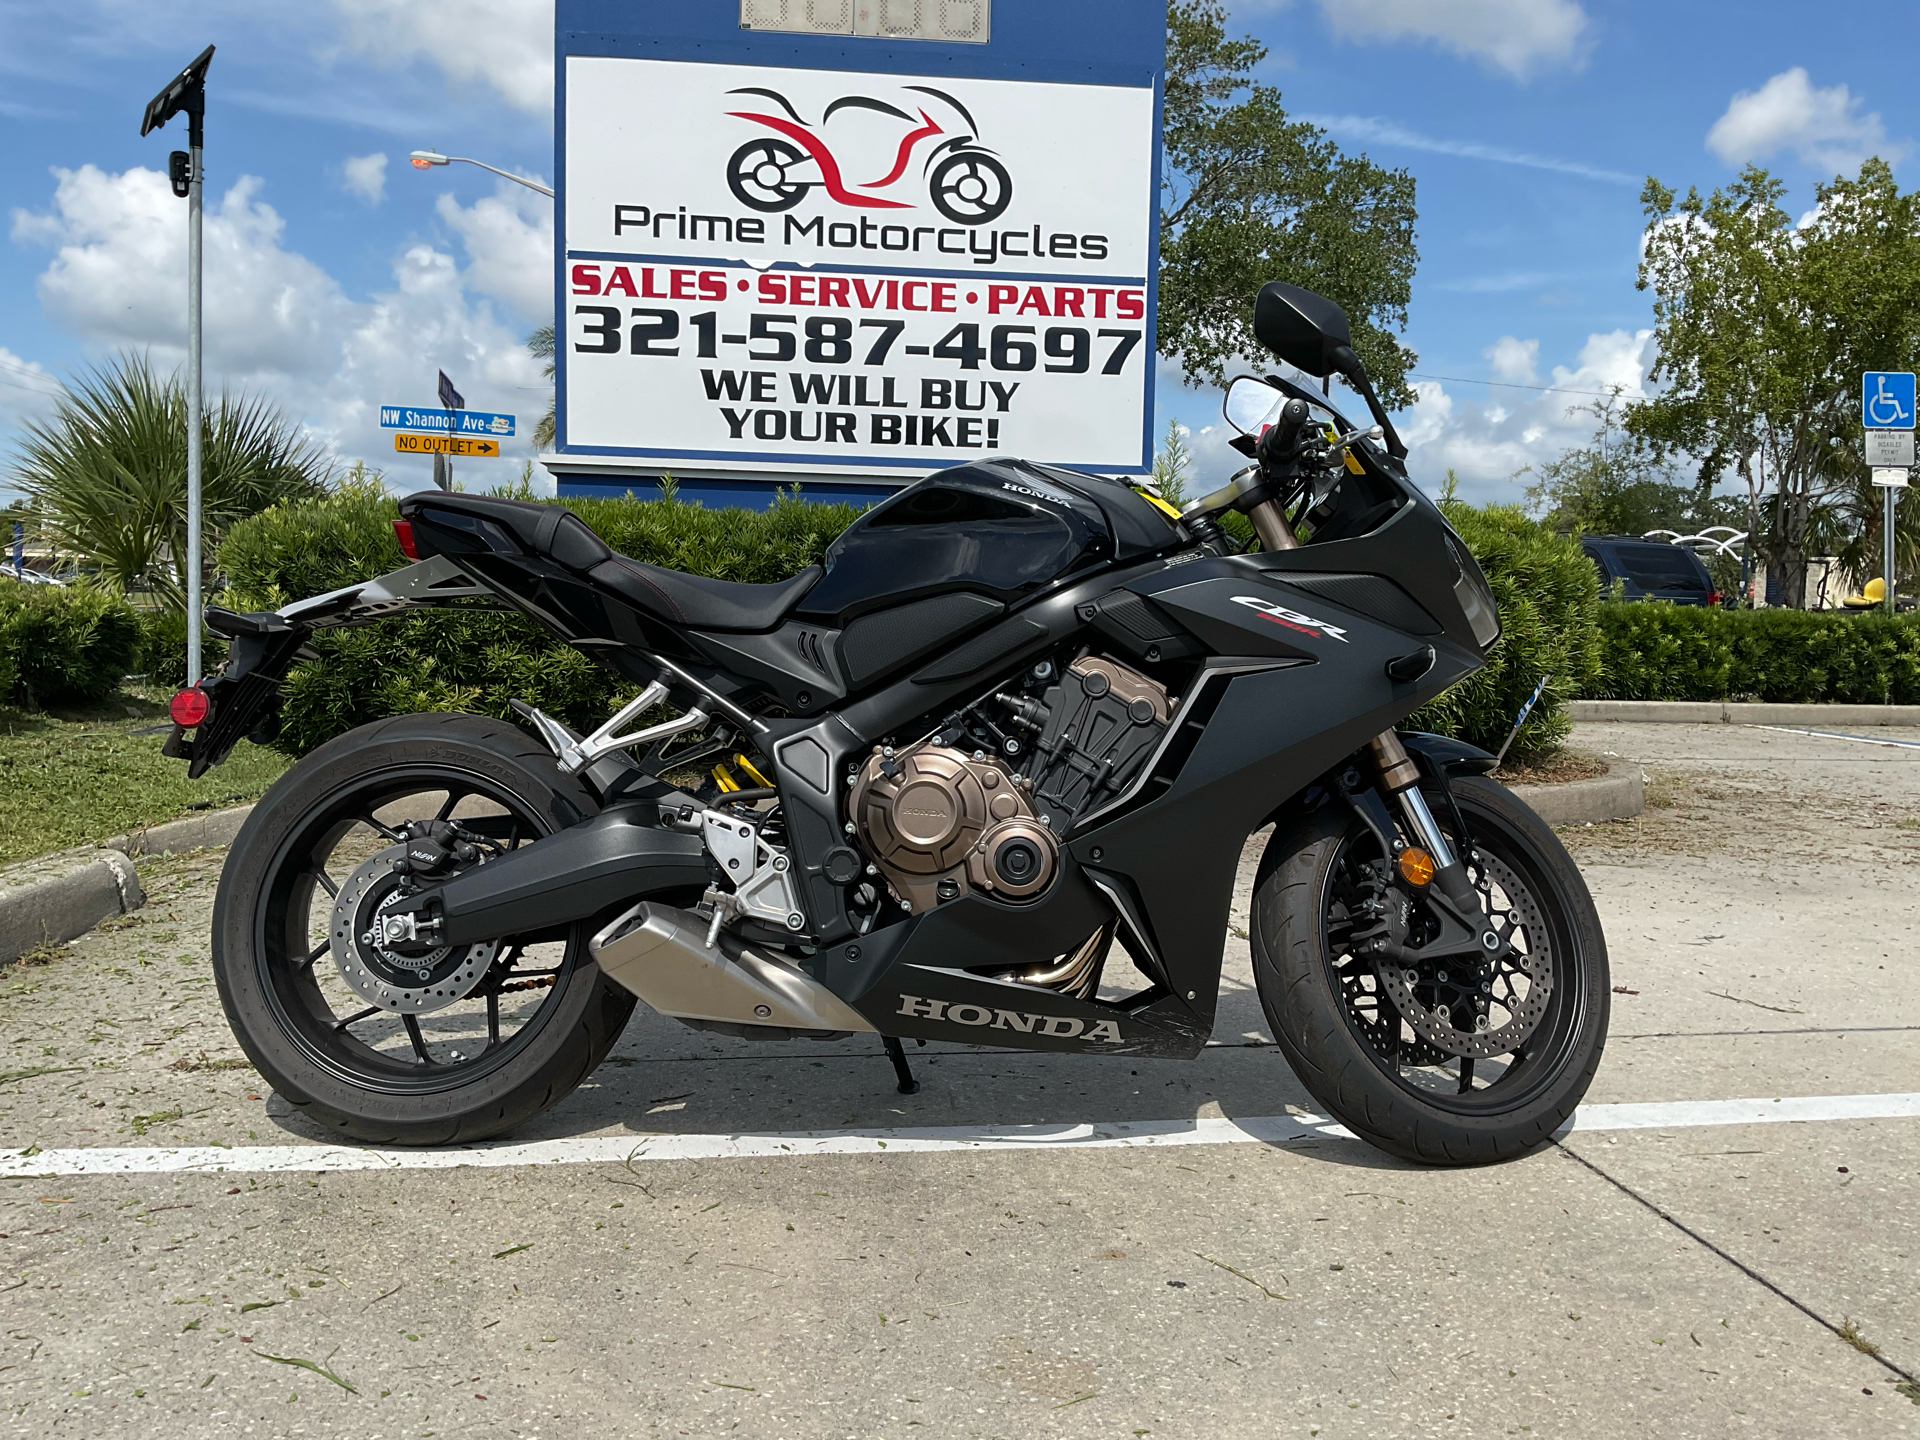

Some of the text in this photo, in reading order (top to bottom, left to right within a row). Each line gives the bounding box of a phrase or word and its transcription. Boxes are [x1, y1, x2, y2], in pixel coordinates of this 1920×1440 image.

[614, 205, 1109, 265] Prime Motorcycles
[572, 264, 1144, 320] SALES SERVICE PARTS
[574, 306, 1142, 375] 321-587-4697
[700, 368, 1021, 413] WE WILL BUY
[382, 409, 400, 425] NW
[405, 410, 457, 430] Shannon
[462, 414, 485, 431] Ave
[719, 407, 999, 449] YOUR BIKE!
[399, 436, 474, 453] NO OUTLET
[1002, 482, 1072, 509] HONDA
[1229, 595, 1350, 644] CBR
[902, 807, 947, 818] HONDA
[896, 994, 1125, 1043] HONDA
